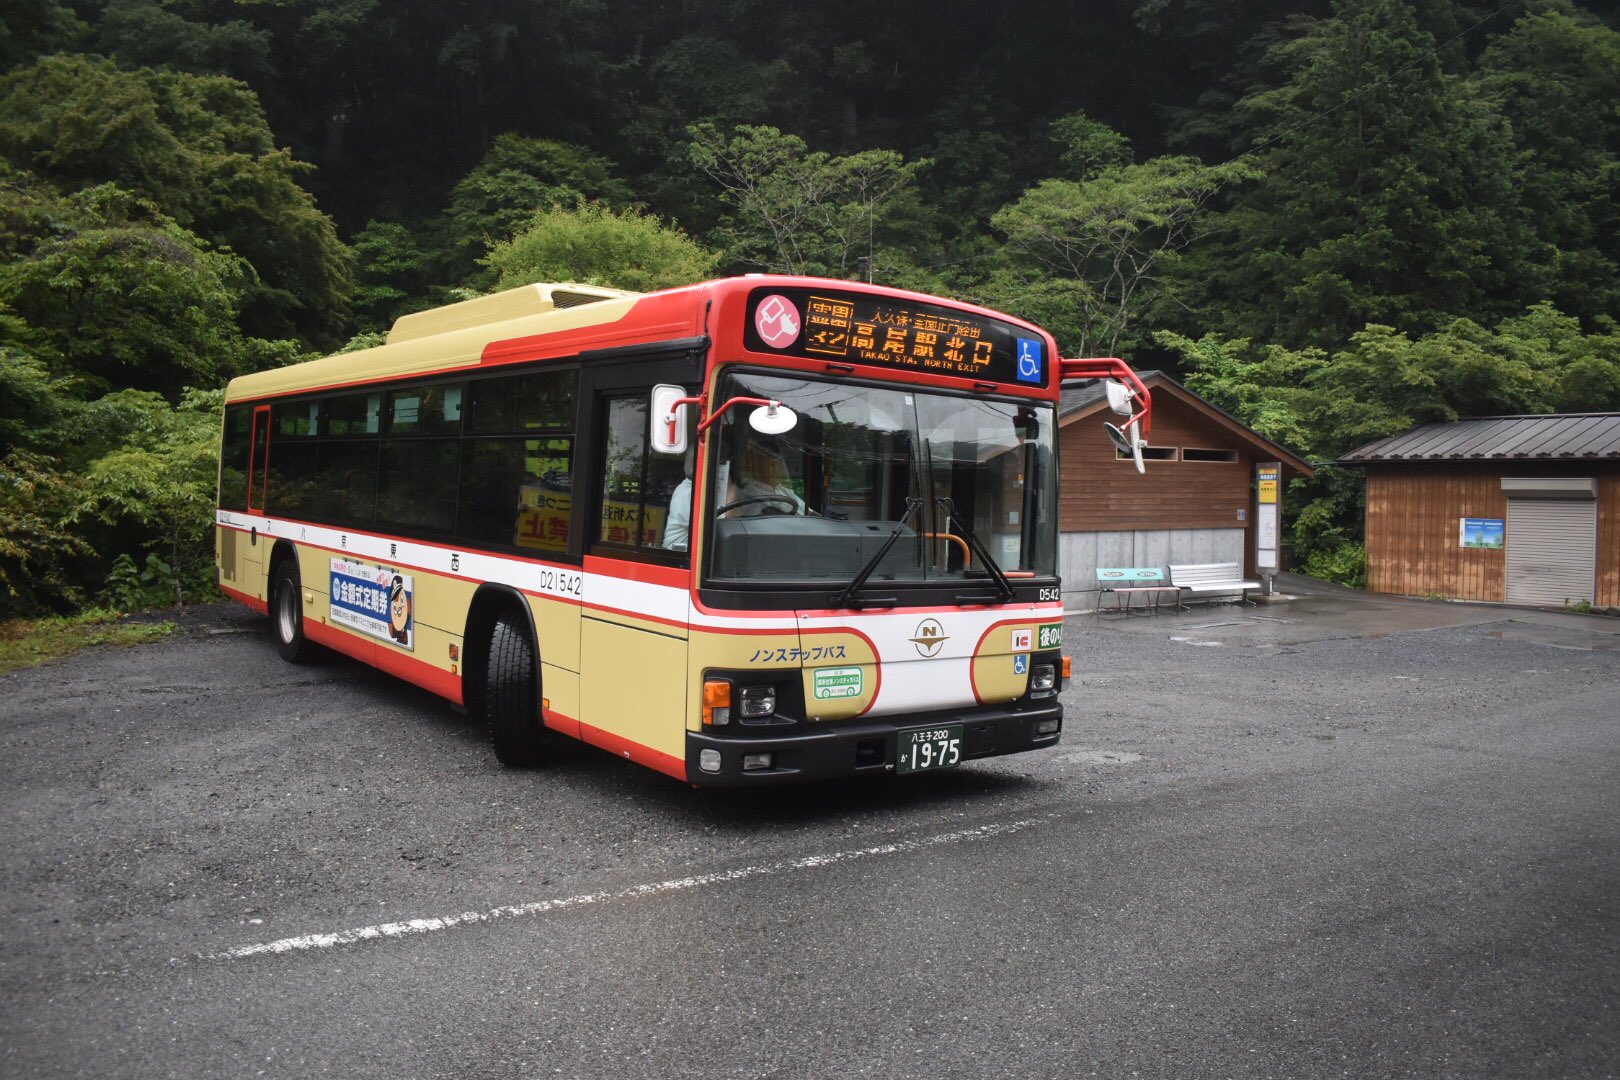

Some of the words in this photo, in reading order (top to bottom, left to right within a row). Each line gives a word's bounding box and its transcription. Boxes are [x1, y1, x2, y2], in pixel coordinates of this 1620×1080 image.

[851, 322, 993, 366] 高尾駅北口
[859, 350, 890, 362] TAKAO
[924, 359, 953, 371] NORTH
[957, 363, 981, 374] EXIT
[540, 570, 582, 596] D21542
[1039, 588, 1060, 601] D542
[340, 580, 388, 615] 金額式定期券
[749, 644, 847, 663] ノンステップバス
